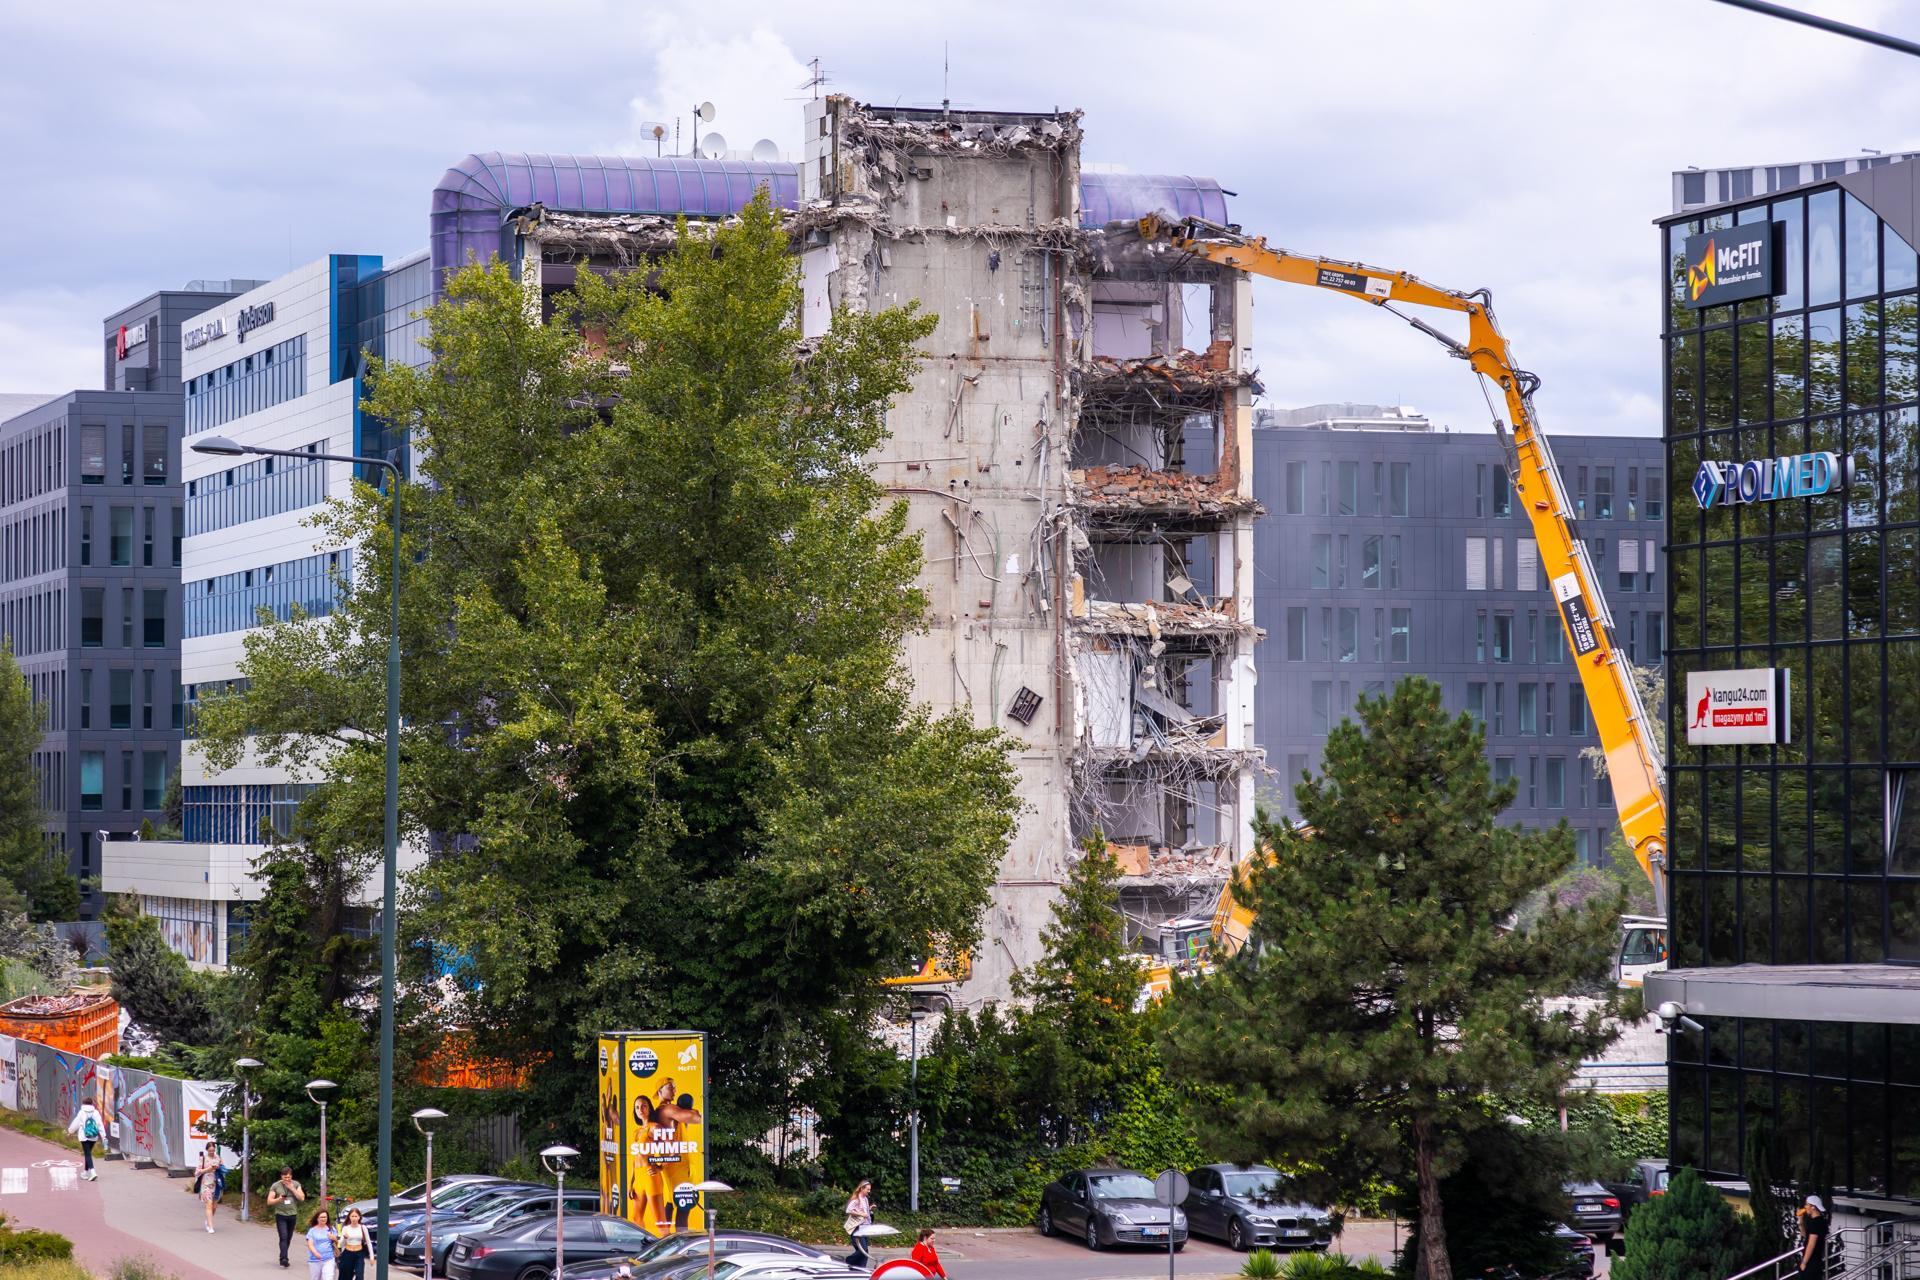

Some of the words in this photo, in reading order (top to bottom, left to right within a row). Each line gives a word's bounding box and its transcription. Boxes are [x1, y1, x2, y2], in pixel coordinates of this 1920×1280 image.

[1718, 240, 1762, 272] McFIT
[237, 302, 274, 343] guidevision
[1724, 452, 1834, 504] POLMED
[1573, 614, 1580, 622] 22
[1576, 621, 1585, 633] 757
[1713, 688, 1767, 705] kangu24.com
[1714, 714, 1744, 725] magazyny
[1745, 712, 1753, 722] od
[653, 1128, 675, 1141] FIT
[630, 1141, 698, 1155] SUMMER
[678, 1198, 686, 1207] 0
